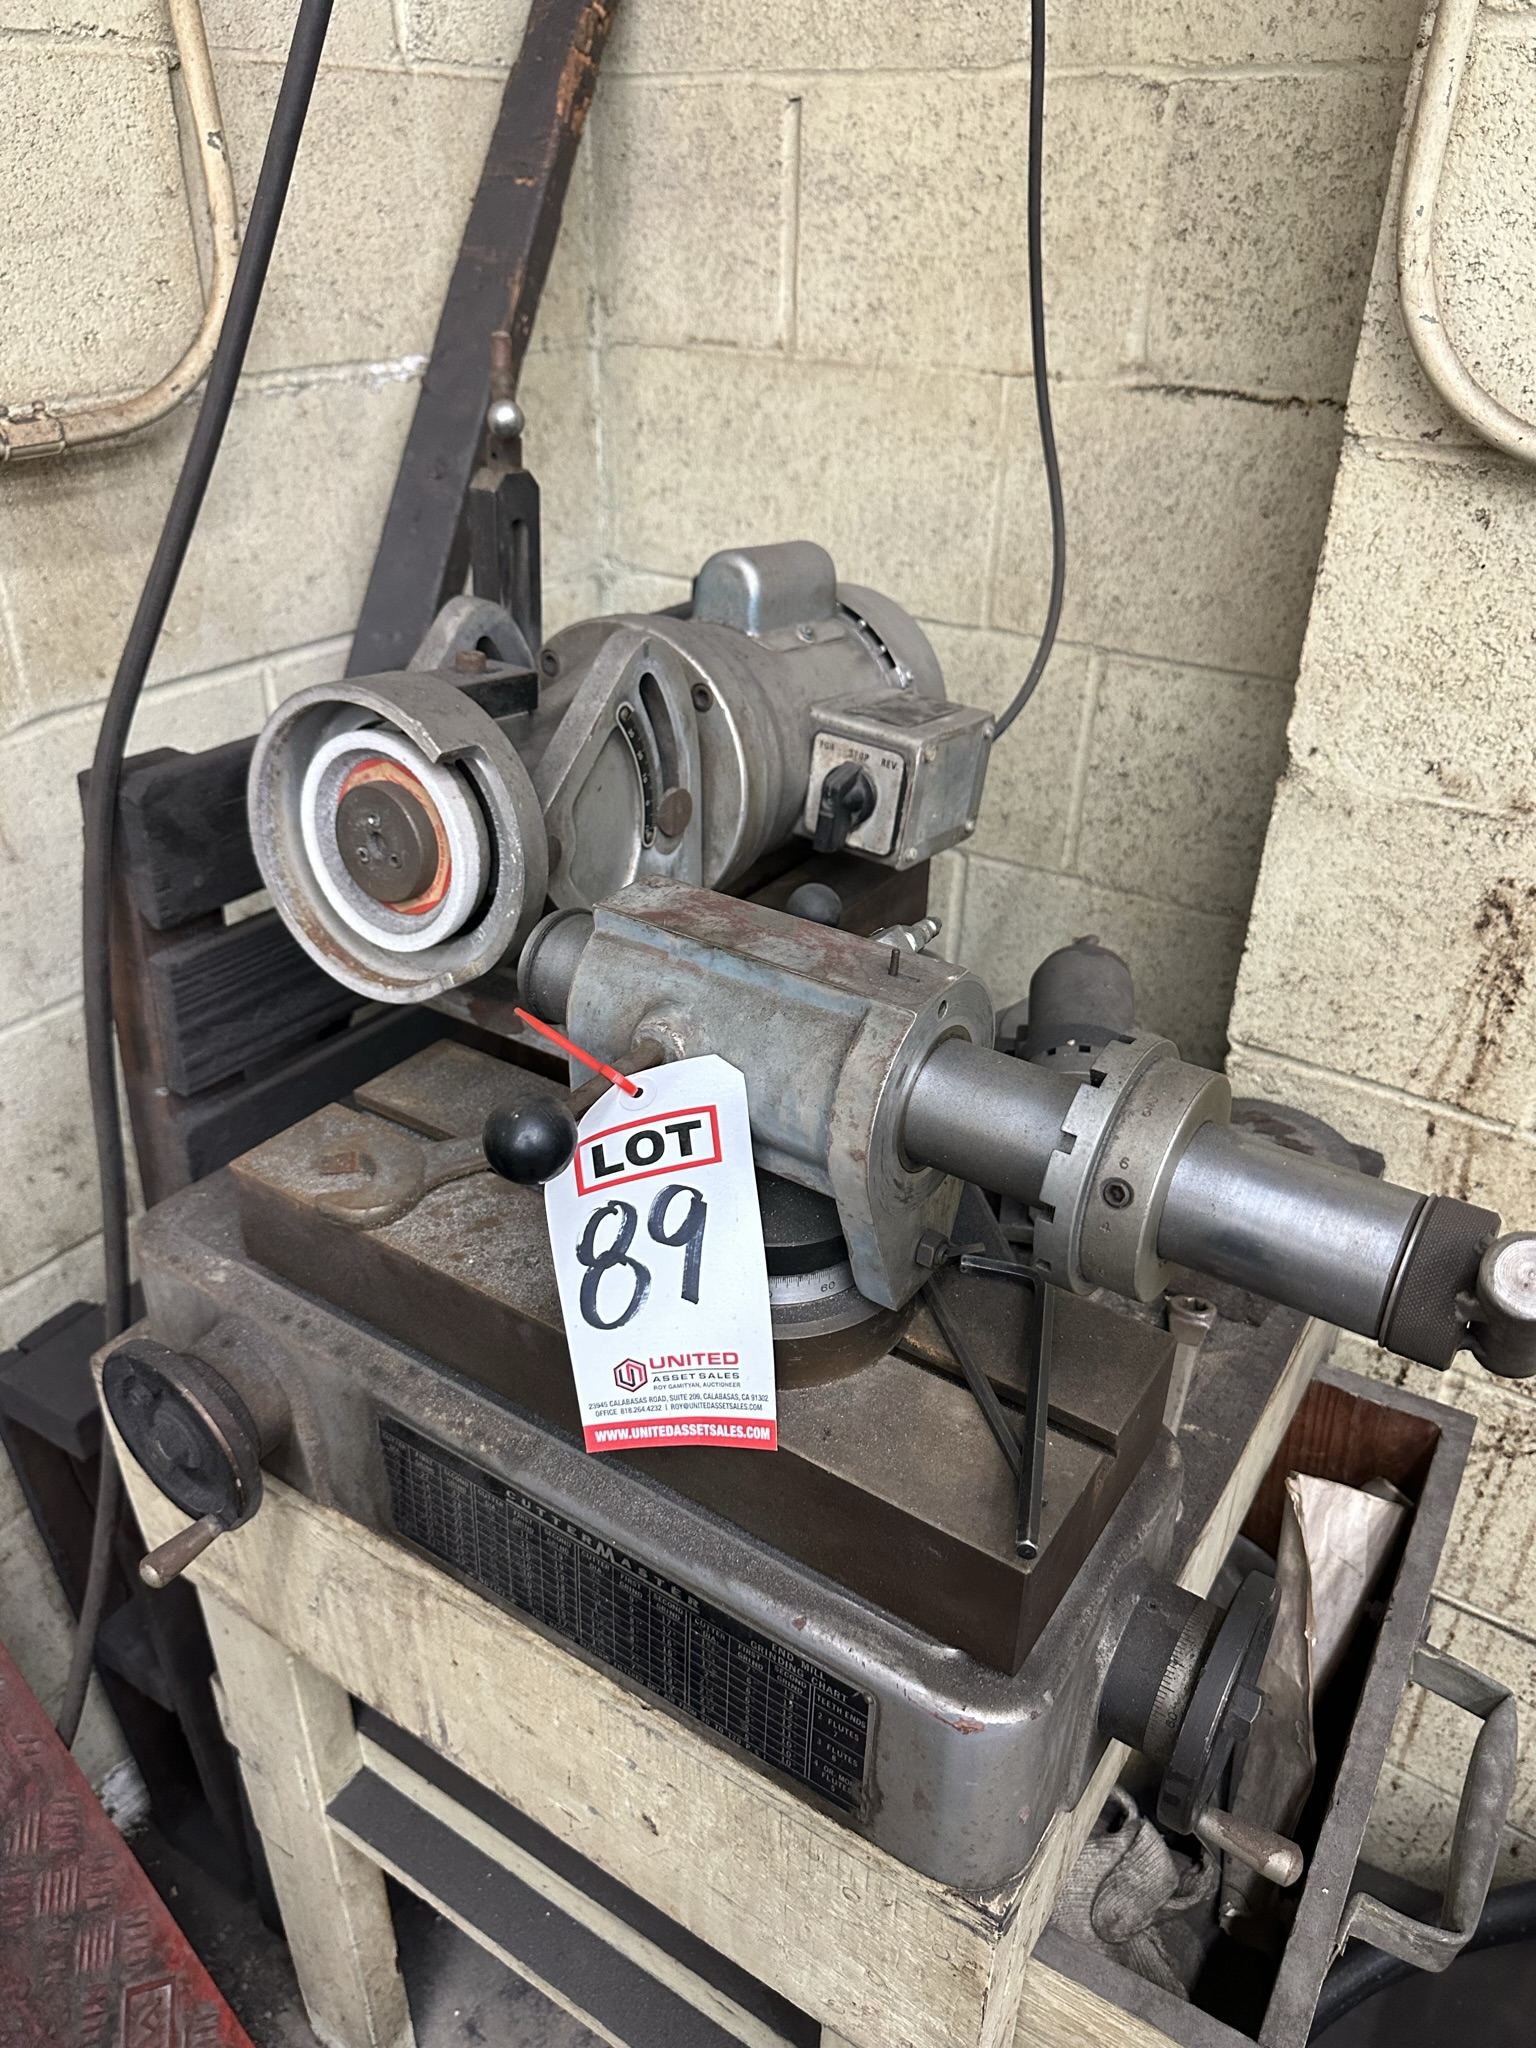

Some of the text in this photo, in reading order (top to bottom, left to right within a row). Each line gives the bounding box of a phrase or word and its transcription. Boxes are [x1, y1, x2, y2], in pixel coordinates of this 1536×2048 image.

[848, 748, 870, 761] STOP
[591, 1119, 701, 1179] LOT
[576, 1184, 707, 1330] 89
[820, 1281, 836, 1292] 60
[649, 1352, 739, 1369] UNITED
[652, 1372, 740, 1382] ASSET SALES
[588, 1401, 609, 1410] 23945
[609, 1398, 648, 1408] CALABASAS
[670, 1394, 688, 1402] SUITE
[703, 1392, 740, 1401] CALABASAS,
[751, 1394, 769, 1402] 91302
[595, 1408, 618, 1417] OFFICE
[670, 1402, 763, 1412] ROY@UNITEDASSETSALES.COM
[594, 1423, 771, 1442] WWW.UNITEDASSETSALES.COM
[513, 1509, 533, 1526] FIRST
[544, 1527, 572, 1549] SECOND
[581, 1549, 610, 1572] CUTTER
[619, 1579, 643, 1600] GRIND
[620, 1572, 641, 1591] FIRST
[653, 1592, 683, 1616] SECOND
[656, 1601, 680, 1622] GRIND
[694, 1616, 726, 1641] CUTTER
[737, 1642, 761, 1662] FIRST
[737, 1650, 764, 1672] GRIND
[771, 1642, 826, 1682] END MILL
[750, 1638, 804, 1678] GRINDING
[810, 1675, 849, 1704] CHART
[774, 1664, 807, 1690] SECOND
[614, 1660, 643, 1684] FILTERED
[679, 1700, 697, 1717] FROM
[776, 1674, 803, 1696] GRIND
[816, 1693, 866, 1730] TEETH ENDS
[1166, 1712, 1177, 1728] 60
[827, 1716, 859, 1743] FLUTES
[826, 1742, 858, 1769] FLUTES
